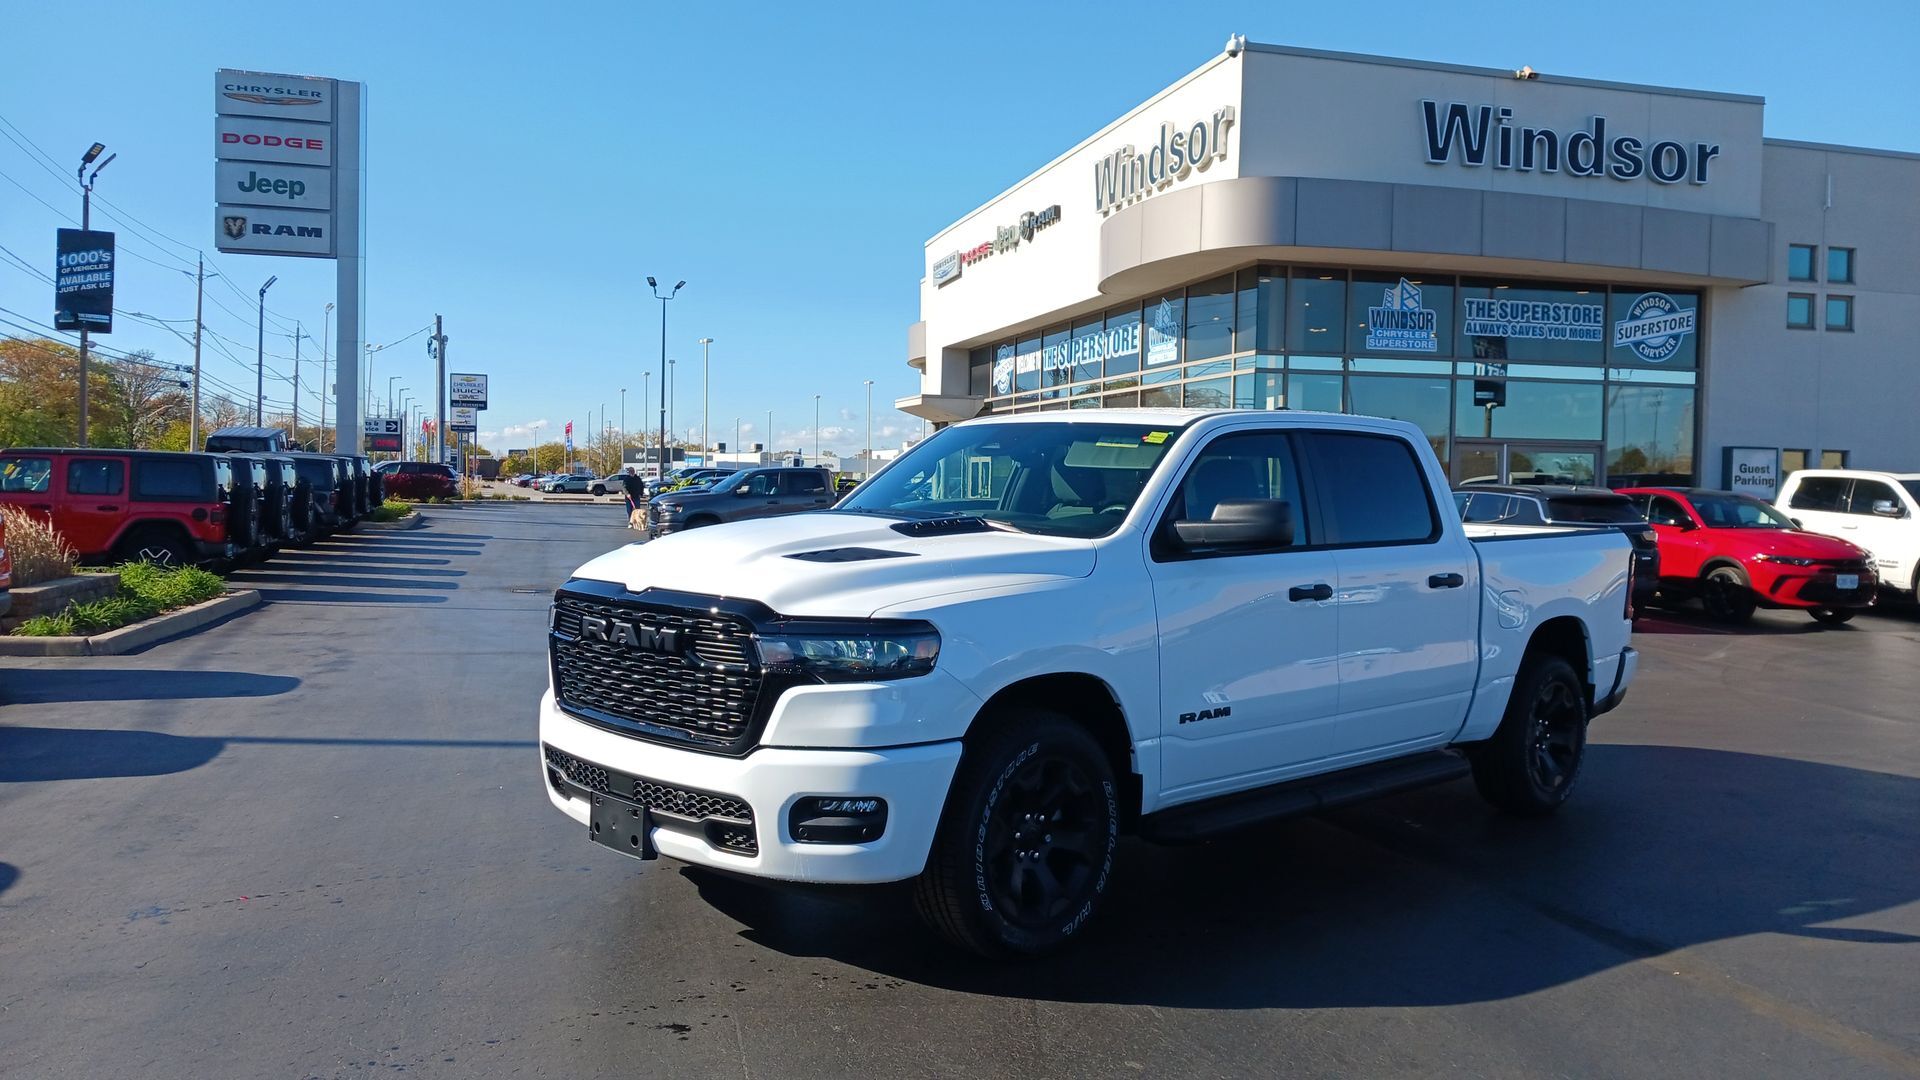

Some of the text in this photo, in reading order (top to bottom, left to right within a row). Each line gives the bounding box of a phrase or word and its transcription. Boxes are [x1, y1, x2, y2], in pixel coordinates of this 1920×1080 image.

[224, 84, 322, 98] CHRYSLER
[222, 133, 323, 150] DODGE
[1422, 99, 1720, 185] Windsor
[1095, 105, 1235, 214] Windsor
[238, 171, 305, 199] Jeep
[1030, 204, 1061, 228] RAM
[252, 223, 323, 238] RAM
[60, 250, 111, 266] 1000's
[933, 254, 956, 272] CHRYSLER
[72, 263, 109, 272] VEHICLES
[59, 272, 111, 286] AVAILABLE
[59, 285, 79, 293] JUST
[1466, 300, 1602, 324] THE SUPERSTORE
[1633, 297, 1671, 316] WINDSOR
[1371, 309, 1434, 330] WINDSOR
[1618, 315, 1692, 340] SUPERSTORE
[1376, 330, 1428, 339] CHRYSLER
[1465, 321, 1602, 340] ALWAYS SAVES YOU MORE!
[1043, 347, 1057, 369] THE
[1059, 325, 1138, 367] SUPERSTORE
[1369, 338, 1435, 349] SUPERSTORE
[1639, 337, 1677, 358] CHRYSLER
[1739, 463, 1770, 474] Guest
[1734, 474, 1775, 488] Parking
[582, 616, 679, 653] RAM
[1179, 706, 1231, 724] RAM
